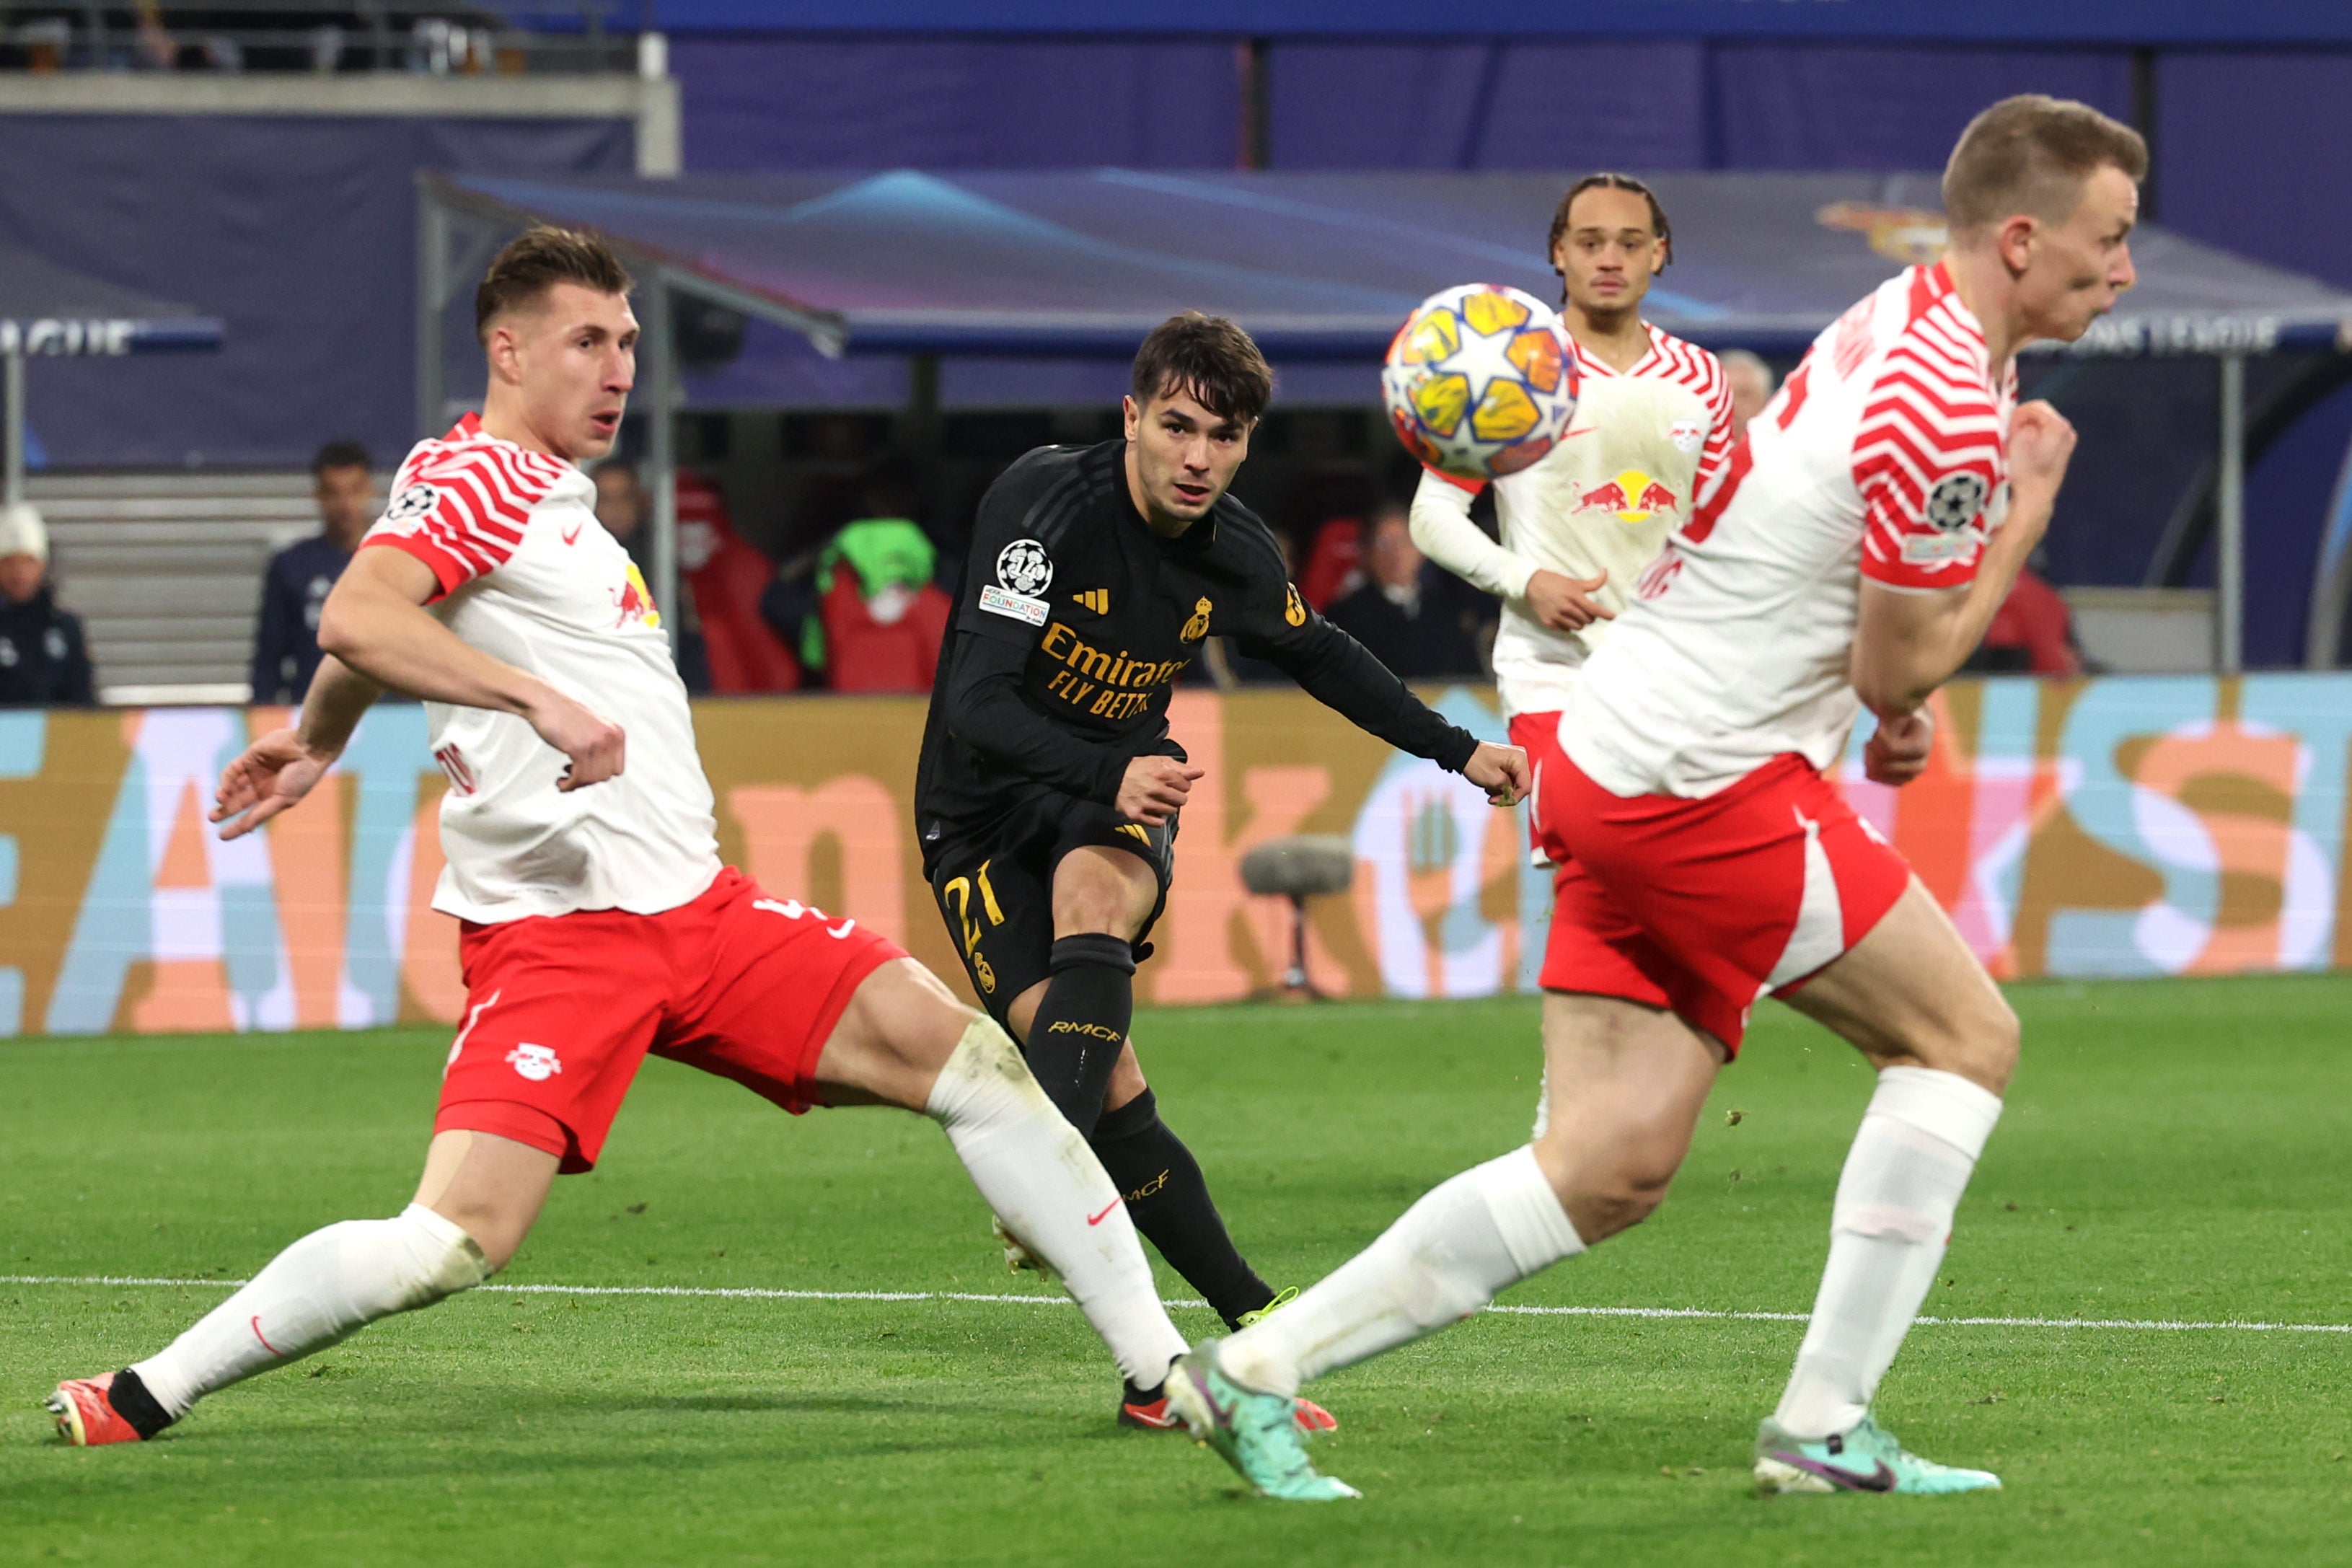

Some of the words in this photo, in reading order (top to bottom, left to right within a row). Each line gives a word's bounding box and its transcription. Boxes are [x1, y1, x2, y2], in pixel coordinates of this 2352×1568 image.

[1010, 555, 1039, 583] 14
[983, 593, 1047, 618] FOUNDATION
[1047, 669, 1095, 705] FLY
[944, 858, 1005, 959] 21
[1047, 1021, 1121, 1041] RMCF
[1122, 1168, 1169, 1201] MCF
